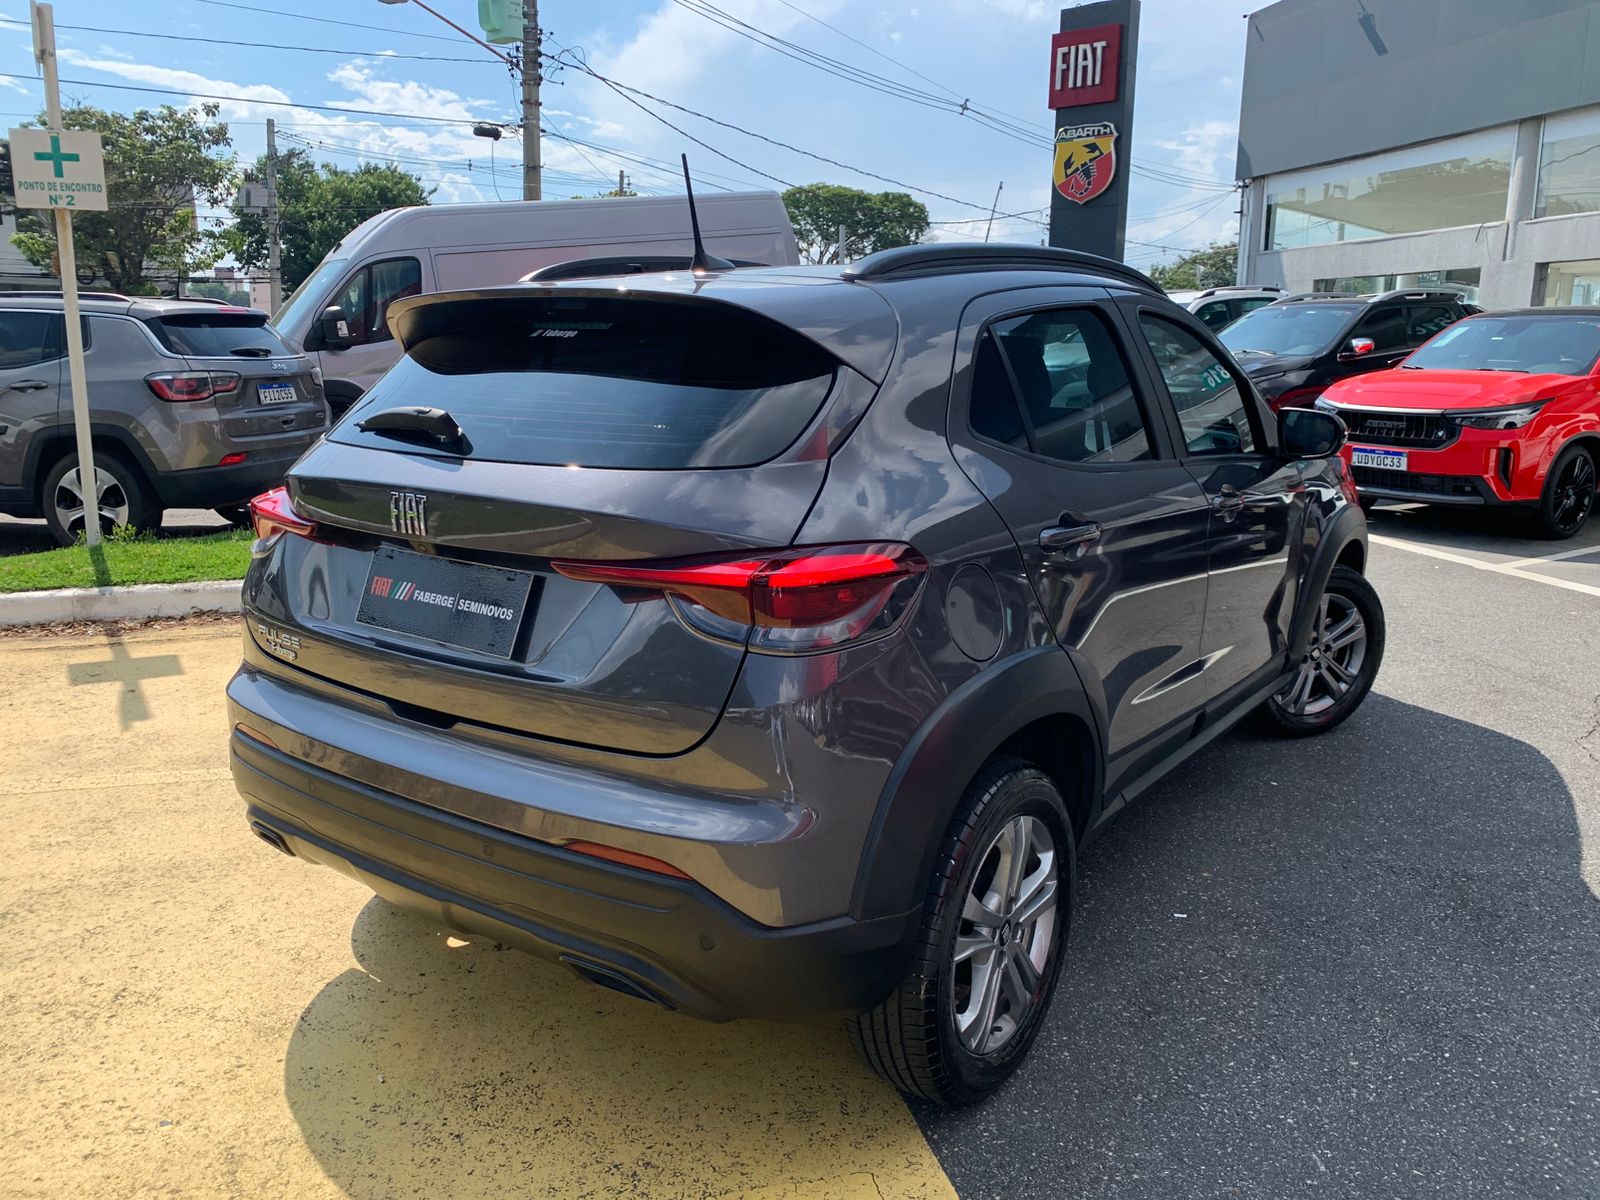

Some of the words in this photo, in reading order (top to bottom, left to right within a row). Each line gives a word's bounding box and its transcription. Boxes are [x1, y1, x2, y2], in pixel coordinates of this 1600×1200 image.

[1054, 40, 1107, 91] FIAT
[1058, 126, 1111, 140] ABARTH
[18, 181, 45, 191] PONTO
[47, 182, 58, 191] DE
[60, 182, 103, 193] ENCONTRO
[65, 195, 76, 206] 2
[390, 491, 427, 536] FIAT
[370, 576, 394, 597] FIAT
[413, 589, 455, 608] FABERGE
[457, 599, 514, 621] SEMINOVOS
[258, 624, 301, 649] PULSE
